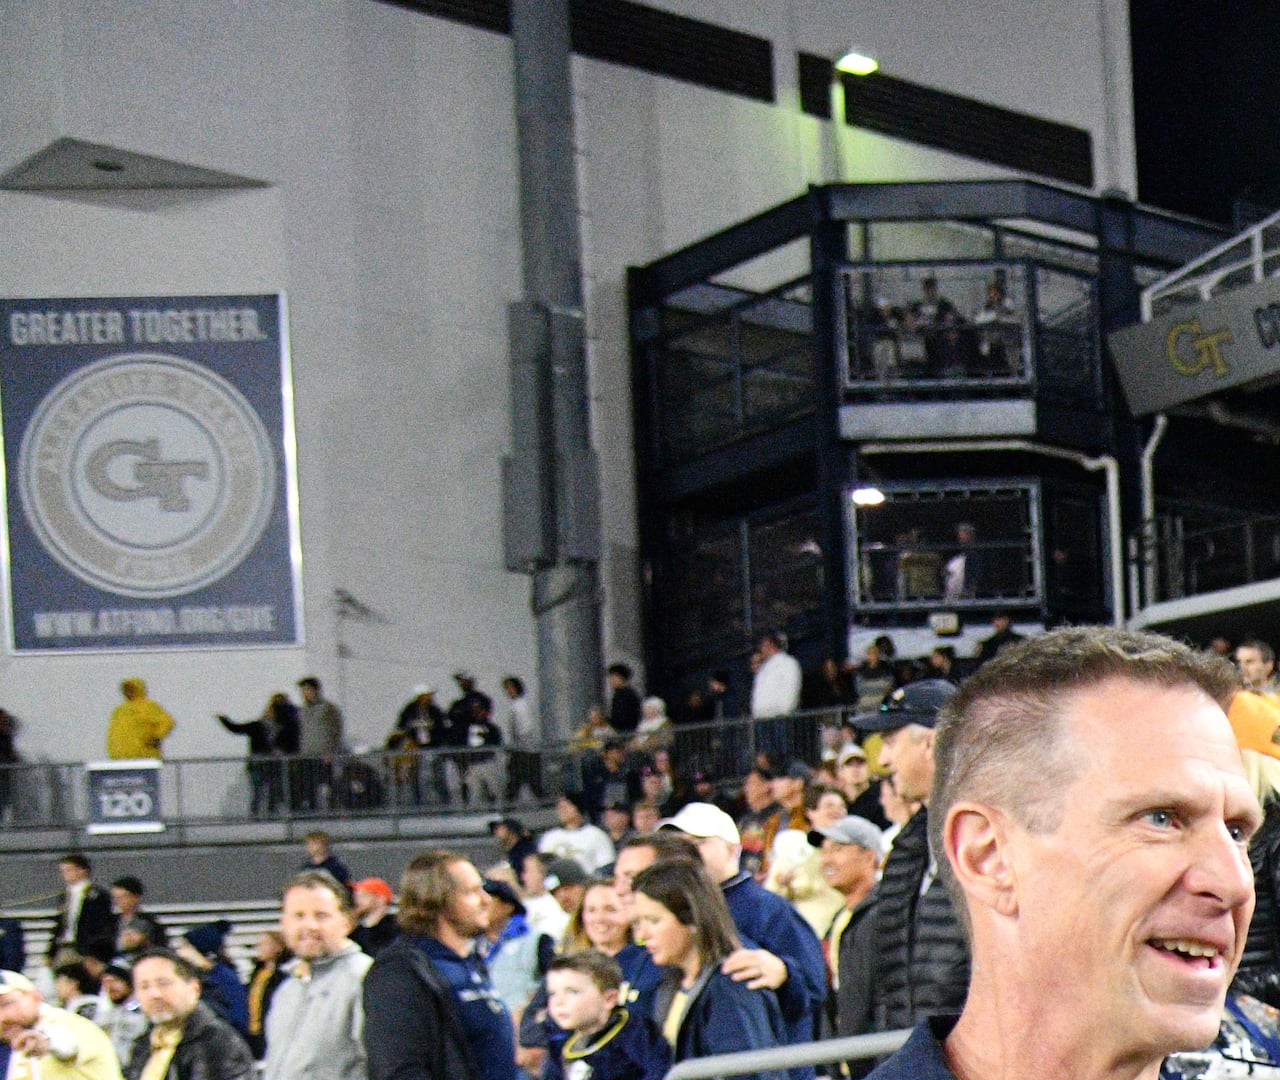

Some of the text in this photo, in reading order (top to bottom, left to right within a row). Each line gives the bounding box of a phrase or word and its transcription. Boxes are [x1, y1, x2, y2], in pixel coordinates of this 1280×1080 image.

[10, 311, 124, 346] GREATER
[1166, 320, 1233, 378] GT
[85, 438, 208, 513] GT
[100, 790, 154, 818] 120
